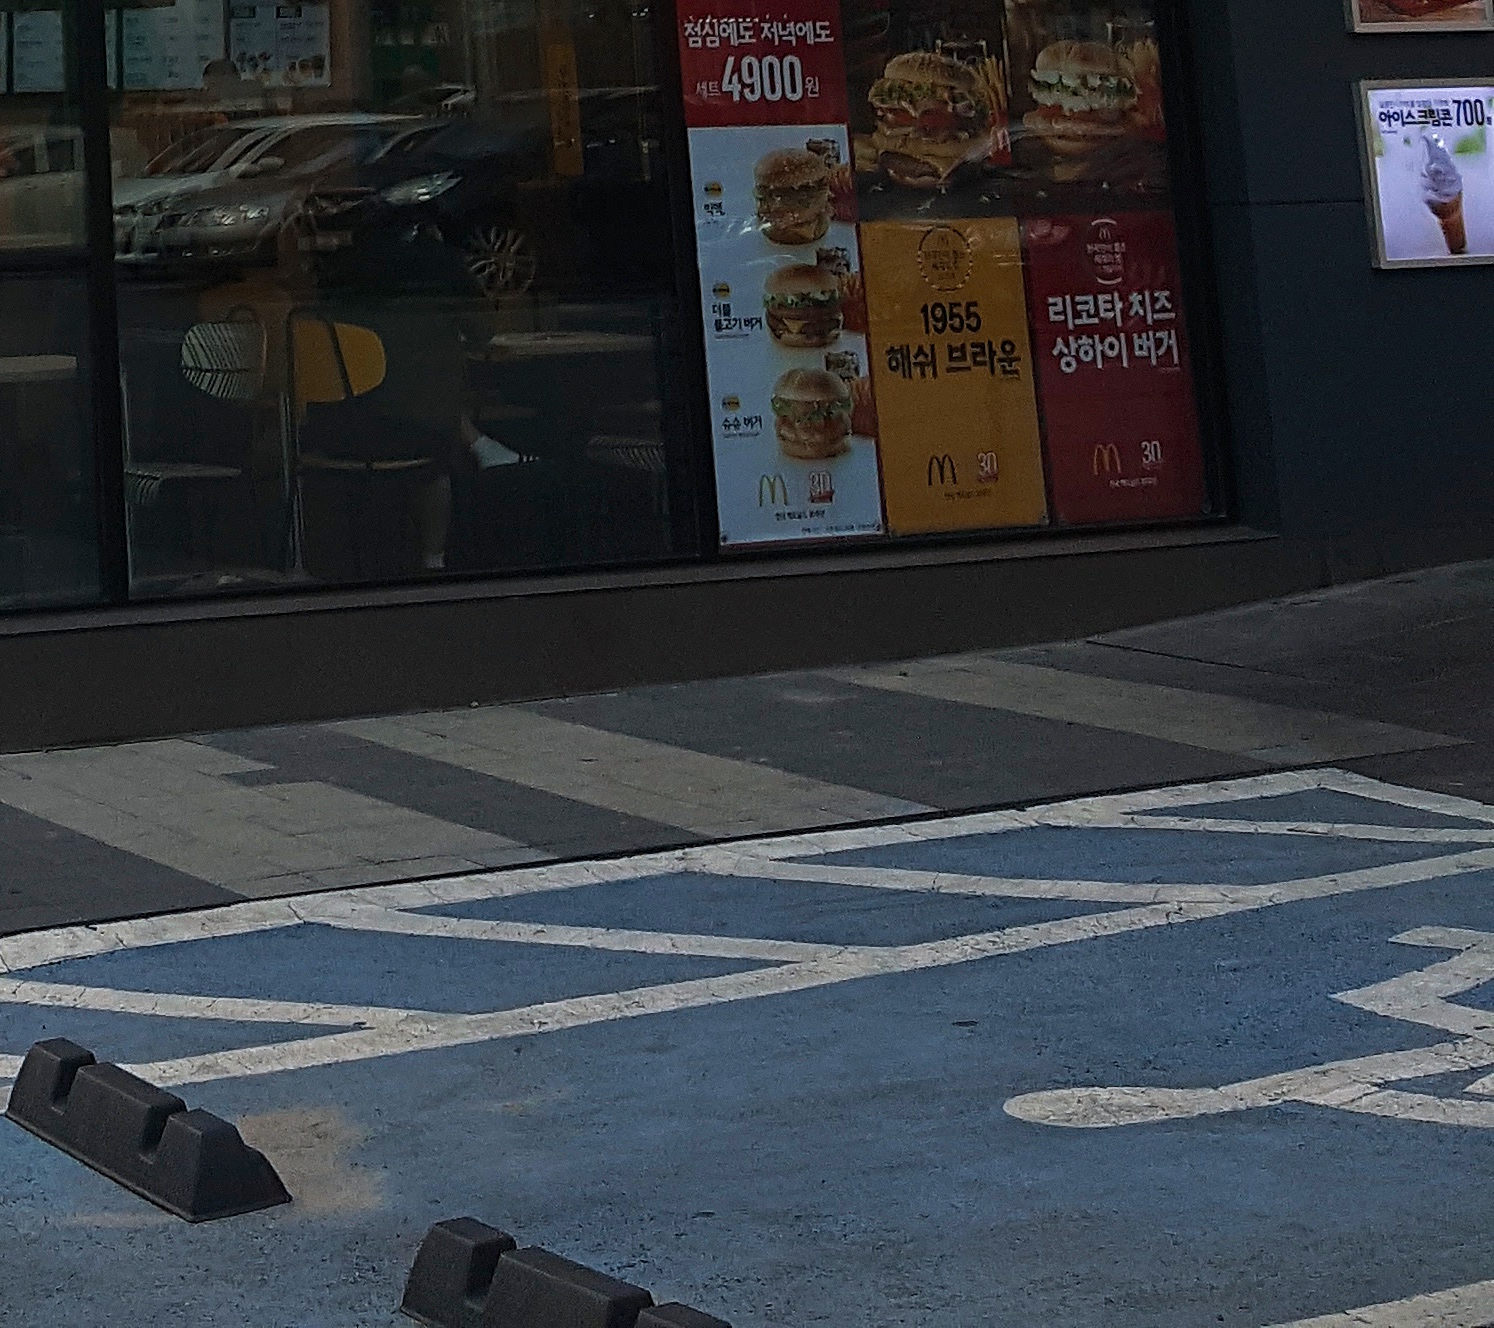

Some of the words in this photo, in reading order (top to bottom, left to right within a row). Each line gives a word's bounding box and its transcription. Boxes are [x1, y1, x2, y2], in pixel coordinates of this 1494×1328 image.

[684, 16, 757, 48] 점심에도
[761, 17, 834, 46] 저녁에도
[1378, 109, 1453, 127] 아이스크림콘
[920, 301, 982, 335] 1955
[1047, 293, 1122, 331] 리코타
[1129, 290, 1176, 326] 치즈
[885, 343, 937, 379] 해쉬
[946, 340, 1022, 379] 브라운
[1052, 332, 1129, 374] 상하이
[1133, 329, 1180, 367] 버거
